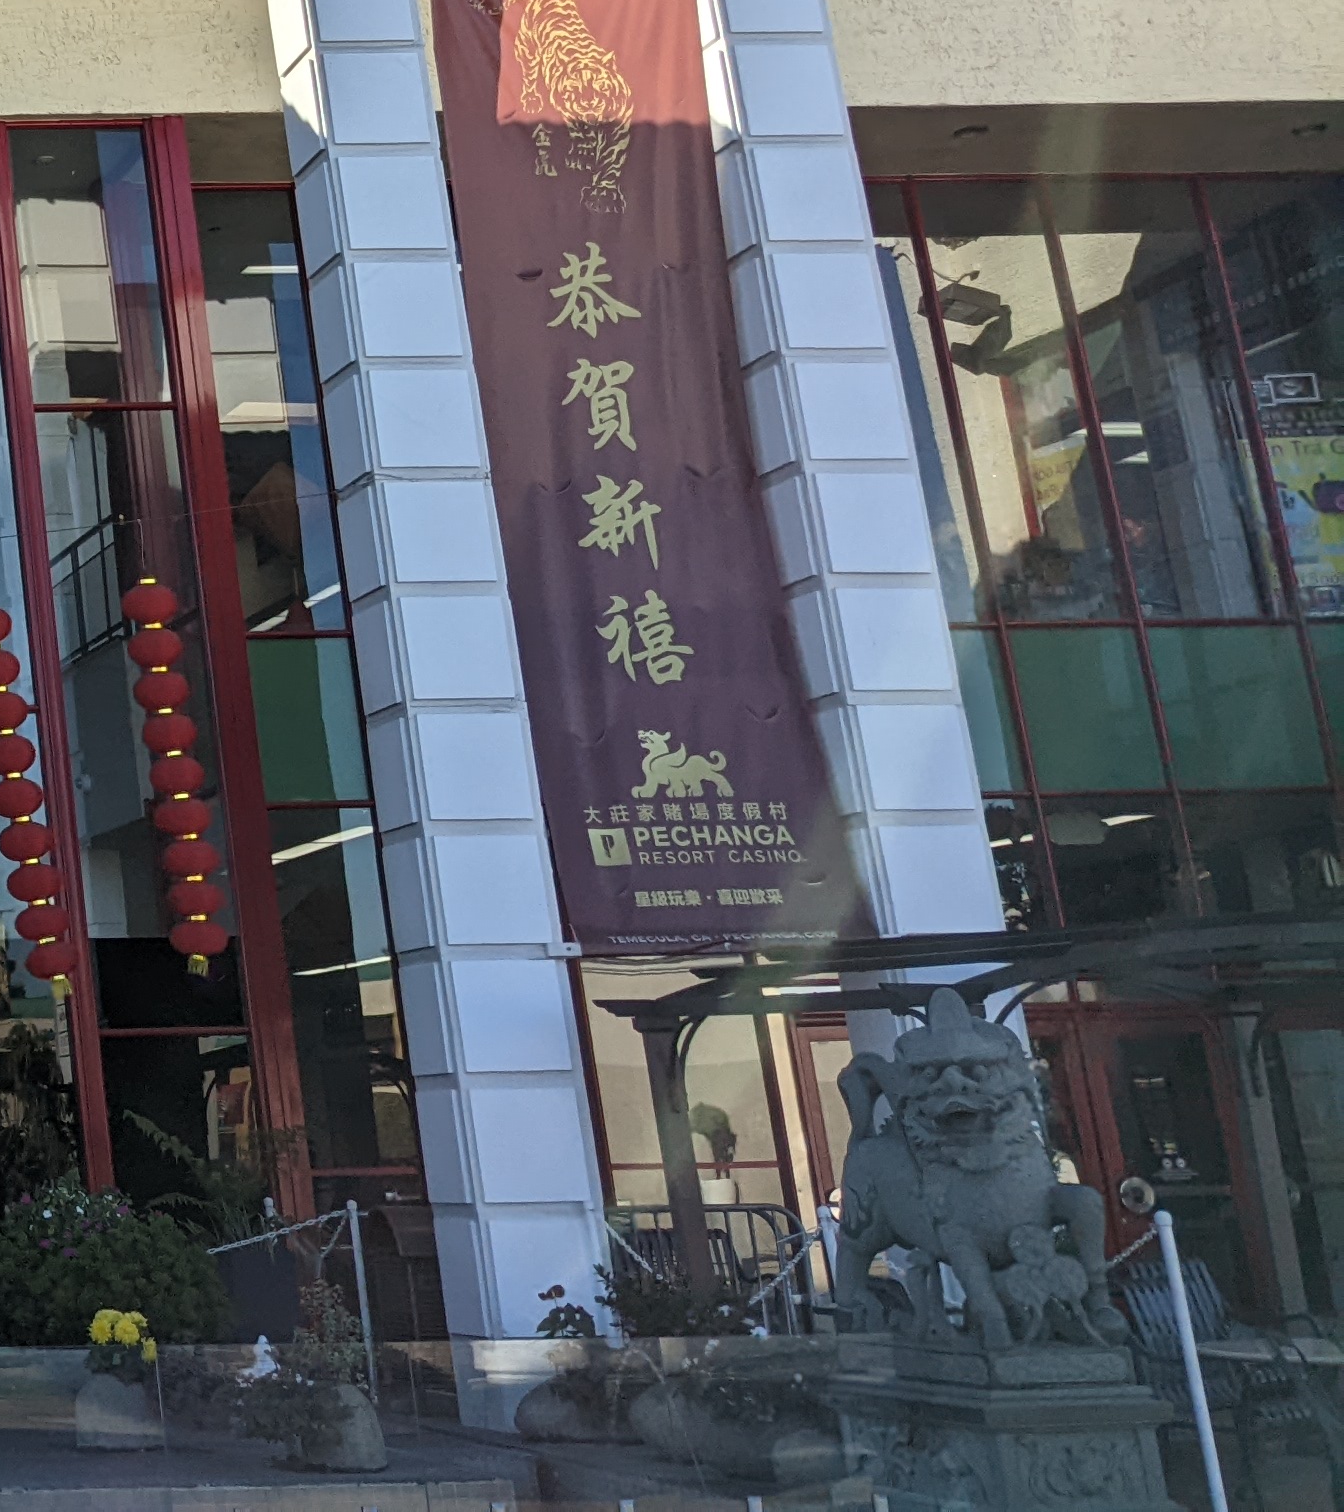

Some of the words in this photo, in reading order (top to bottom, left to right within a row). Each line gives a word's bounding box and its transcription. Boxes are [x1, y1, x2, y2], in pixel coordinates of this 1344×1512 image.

[632, 824, 796, 848] PECHANGA
[638, 850, 716, 866] RESORT
[727, 848, 802, 864] CASINO
